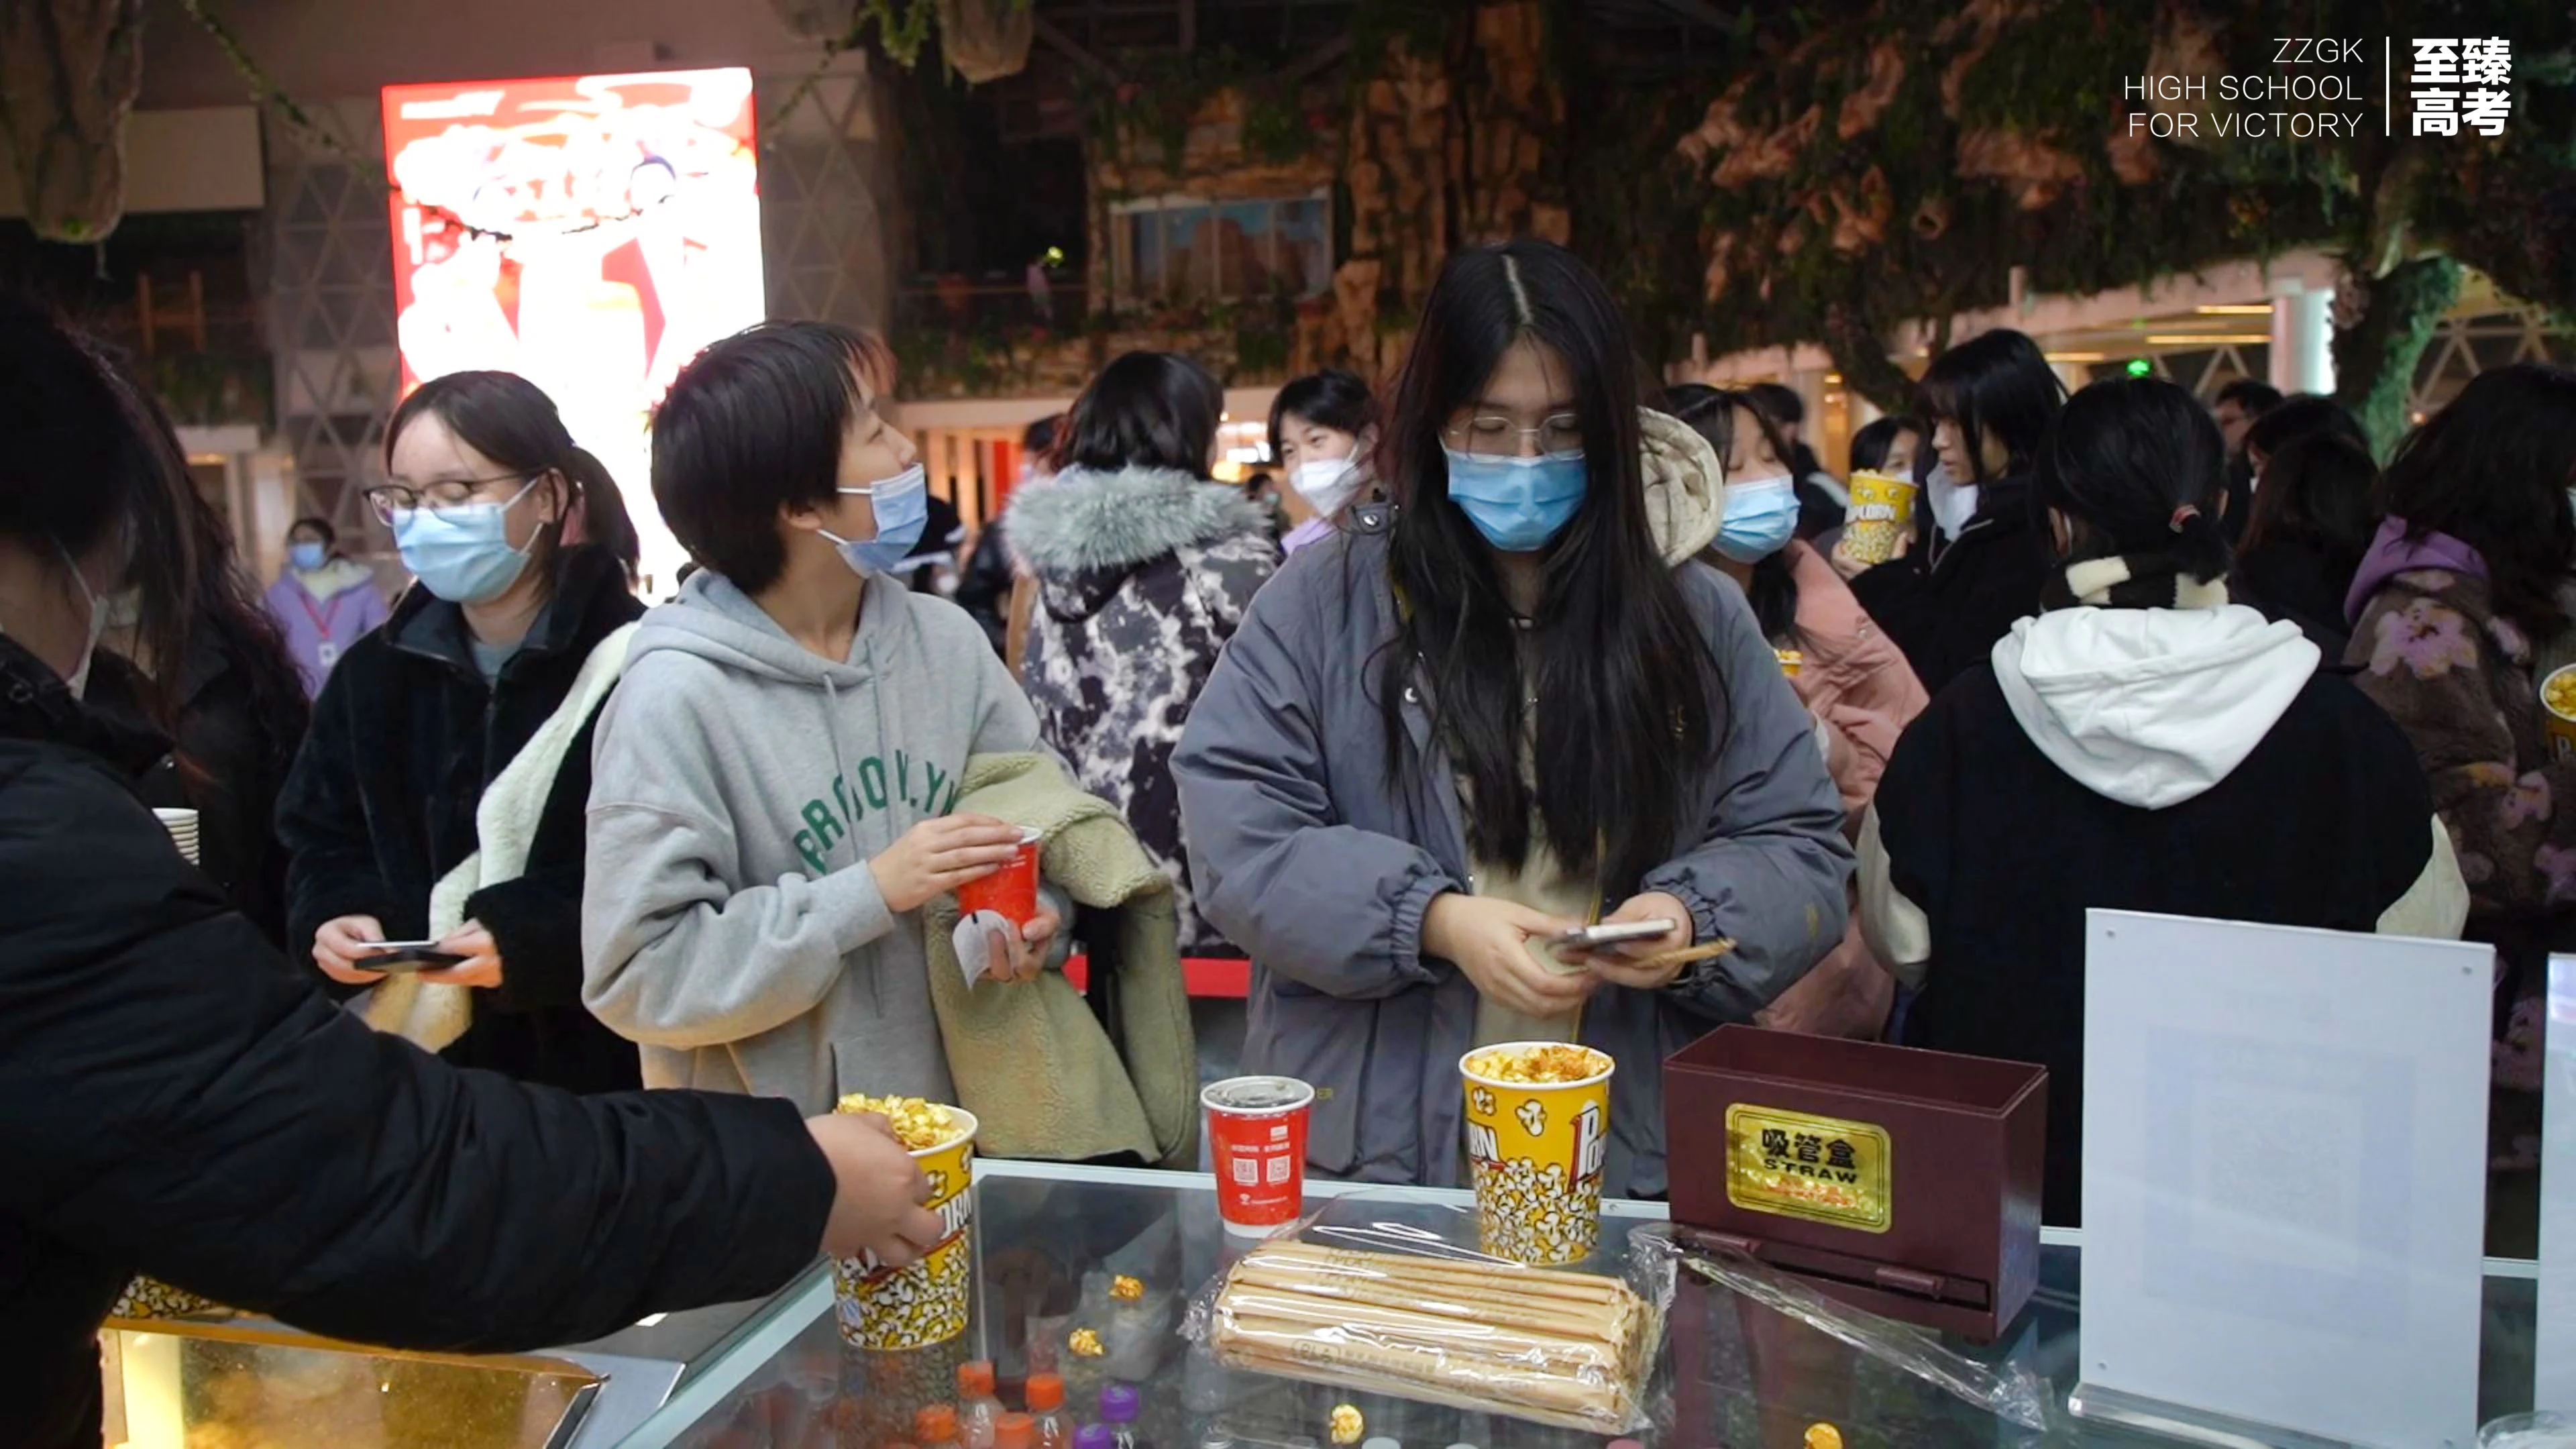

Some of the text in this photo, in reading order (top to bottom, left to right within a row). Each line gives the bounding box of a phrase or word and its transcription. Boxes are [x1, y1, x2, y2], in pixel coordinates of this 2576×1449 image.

[1761, 1128, 1856, 1169] 吸管盒
[1764, 1158, 1858, 1185] STRAW
